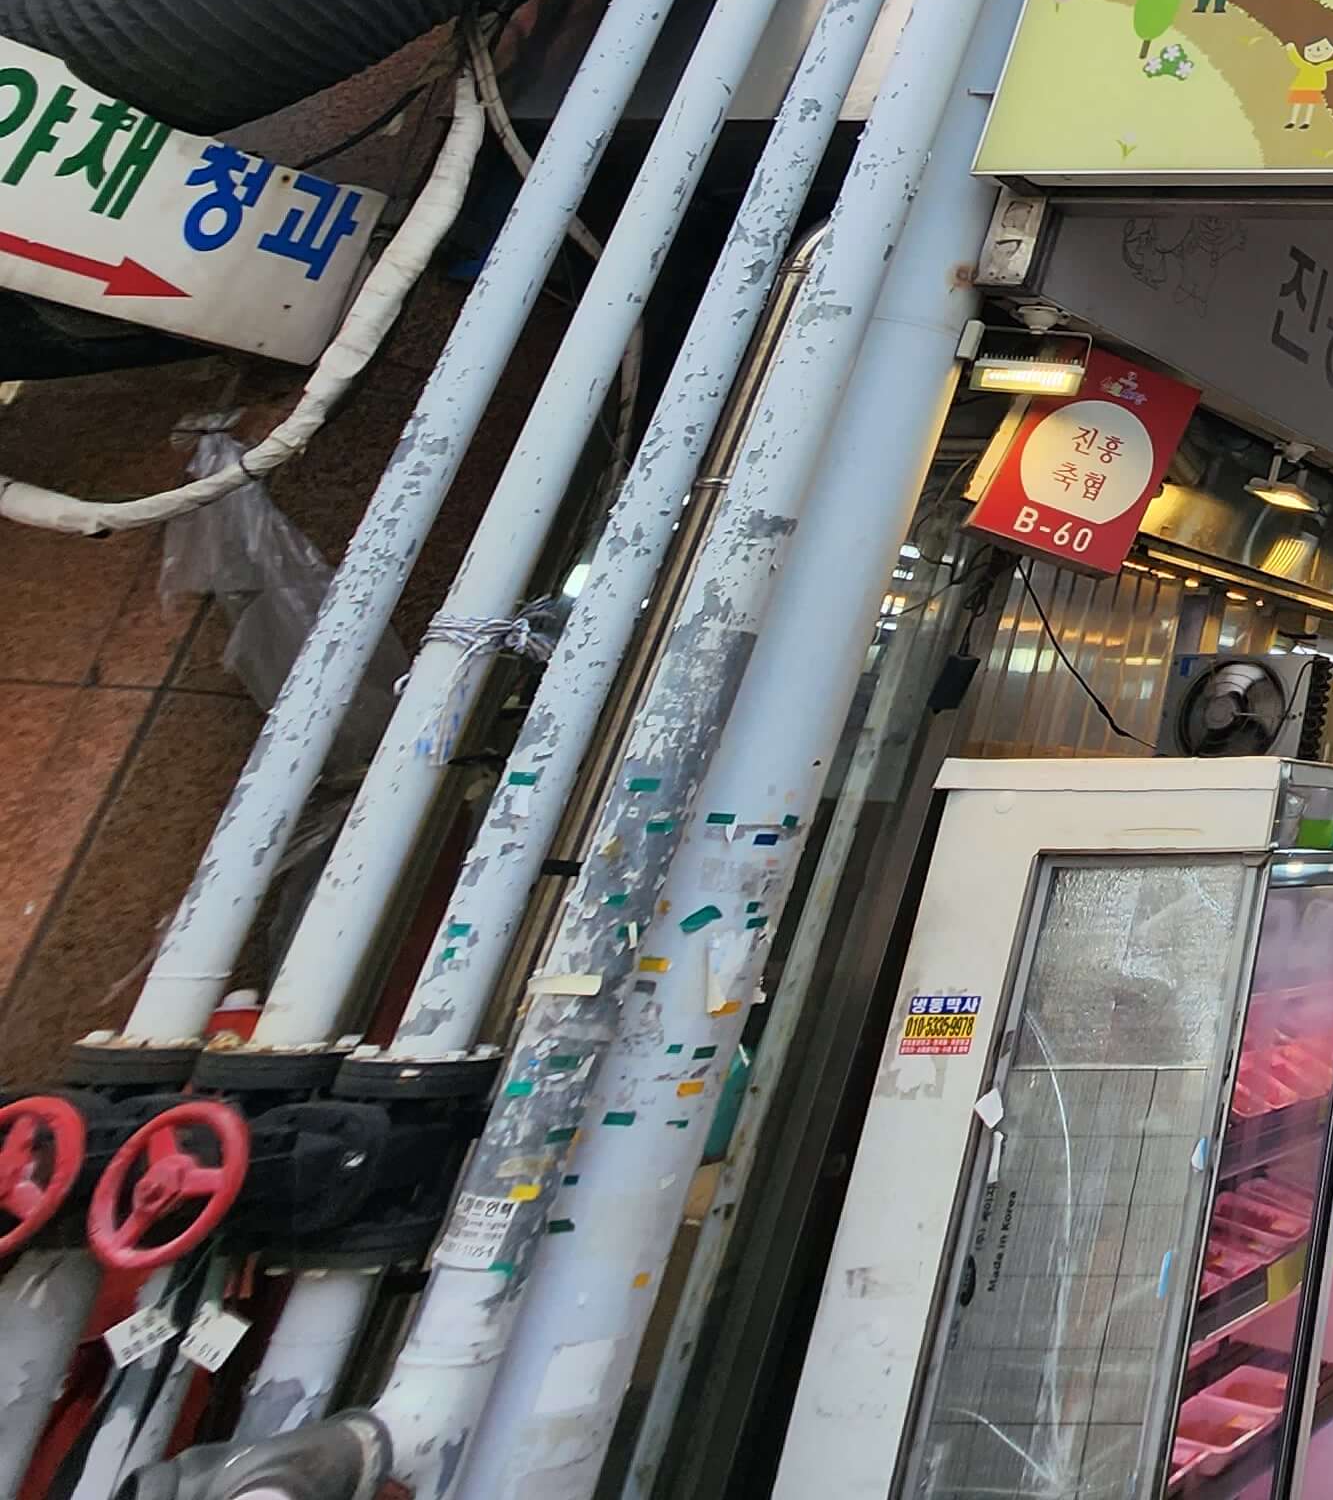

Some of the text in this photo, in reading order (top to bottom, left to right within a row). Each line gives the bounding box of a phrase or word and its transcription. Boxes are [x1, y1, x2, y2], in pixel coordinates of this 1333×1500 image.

[0, 67, 364, 282] 야채 청과
[1072, 426, 1125, 465] 진흥
[1052, 461, 1107, 502] 축협
[1012, 505, 1094, 553] B-60
[911, 996, 979, 1014] 냉동박사
[986, 1251, 1005, 1293] Made
[1001, 1189, 1018, 1232] Korea
